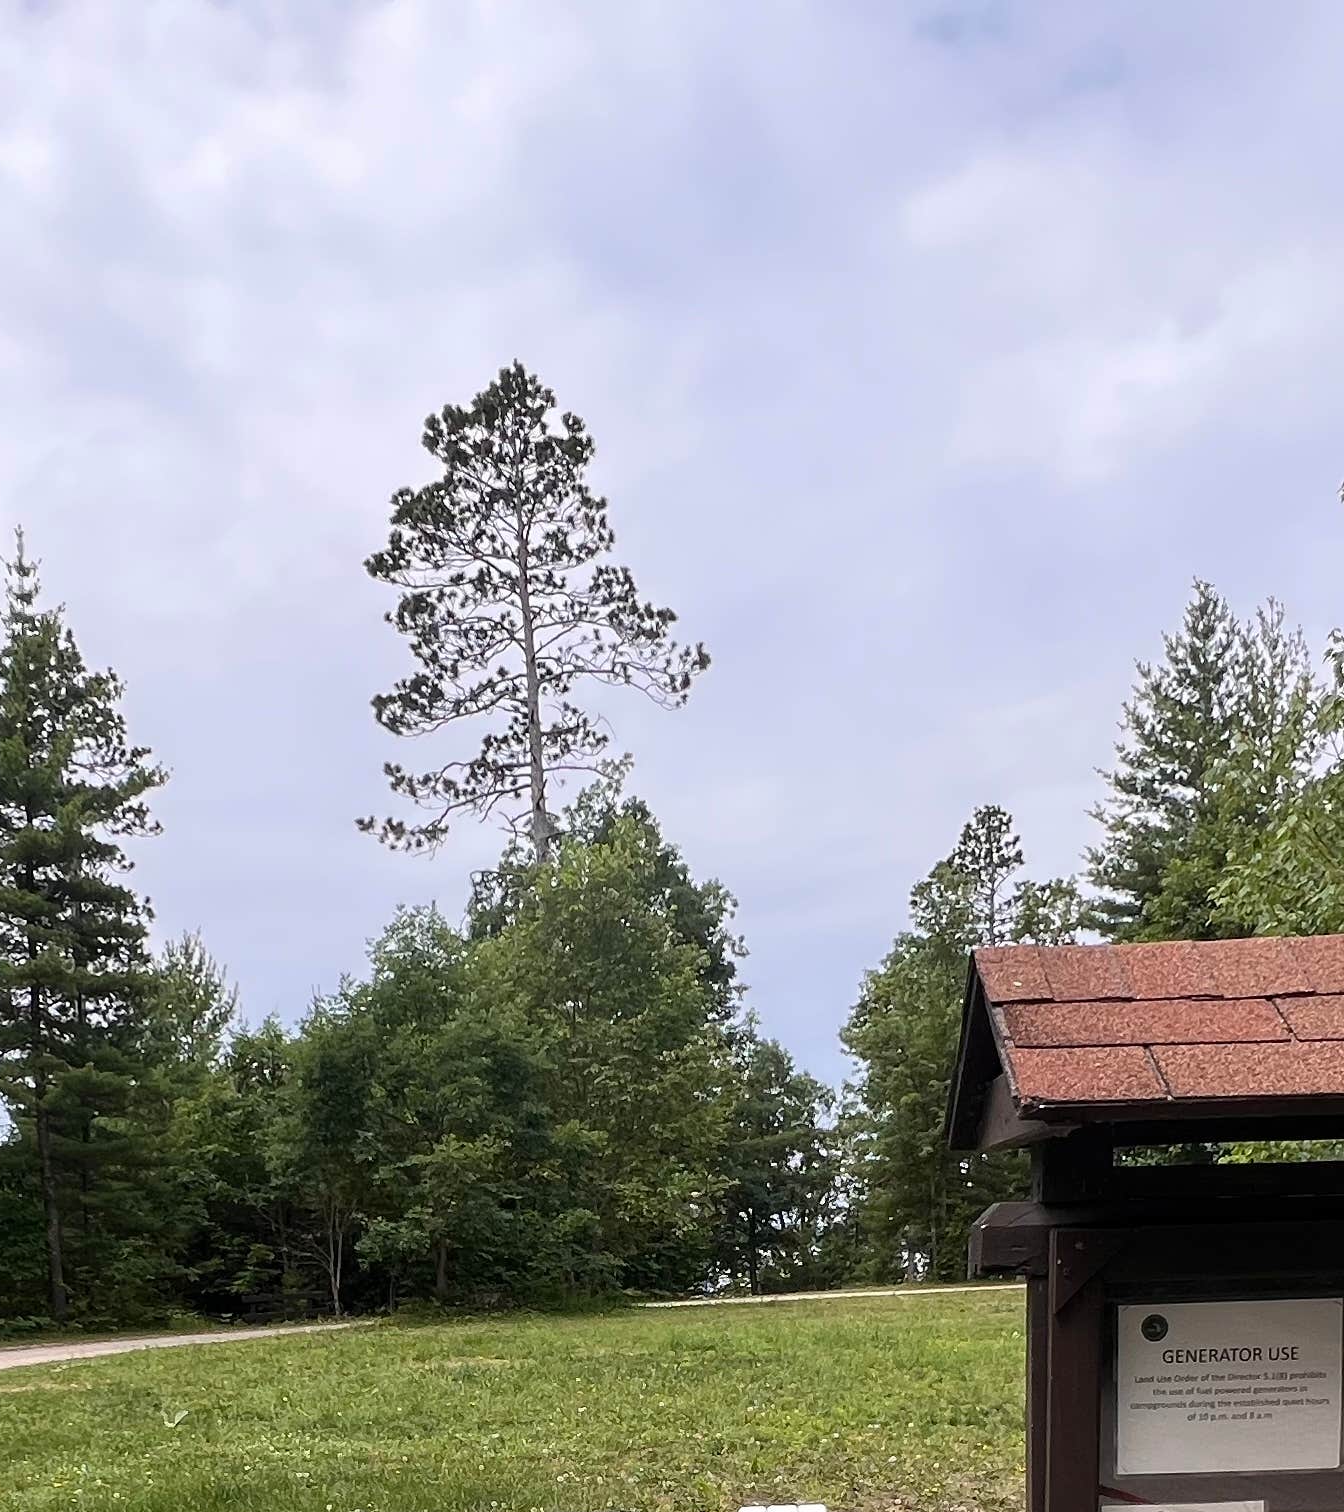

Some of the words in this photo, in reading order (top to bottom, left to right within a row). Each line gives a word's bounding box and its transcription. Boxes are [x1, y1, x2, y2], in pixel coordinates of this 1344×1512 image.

[1162, 1347, 1263, 1364] GENERATOR
[1268, 1346, 1300, 1361] USE
[1157, 1375, 1172, 1383] Use
[1173, 1374, 1197, 1383] Order
[1201, 1373, 1209, 1382] of
[1211, 1373, 1225, 1381] the
[1196, 1387, 1212, 1395] fuel
[1214, 1386, 1252, 1396] powered
[1218, 1400, 1231, 1408] the
